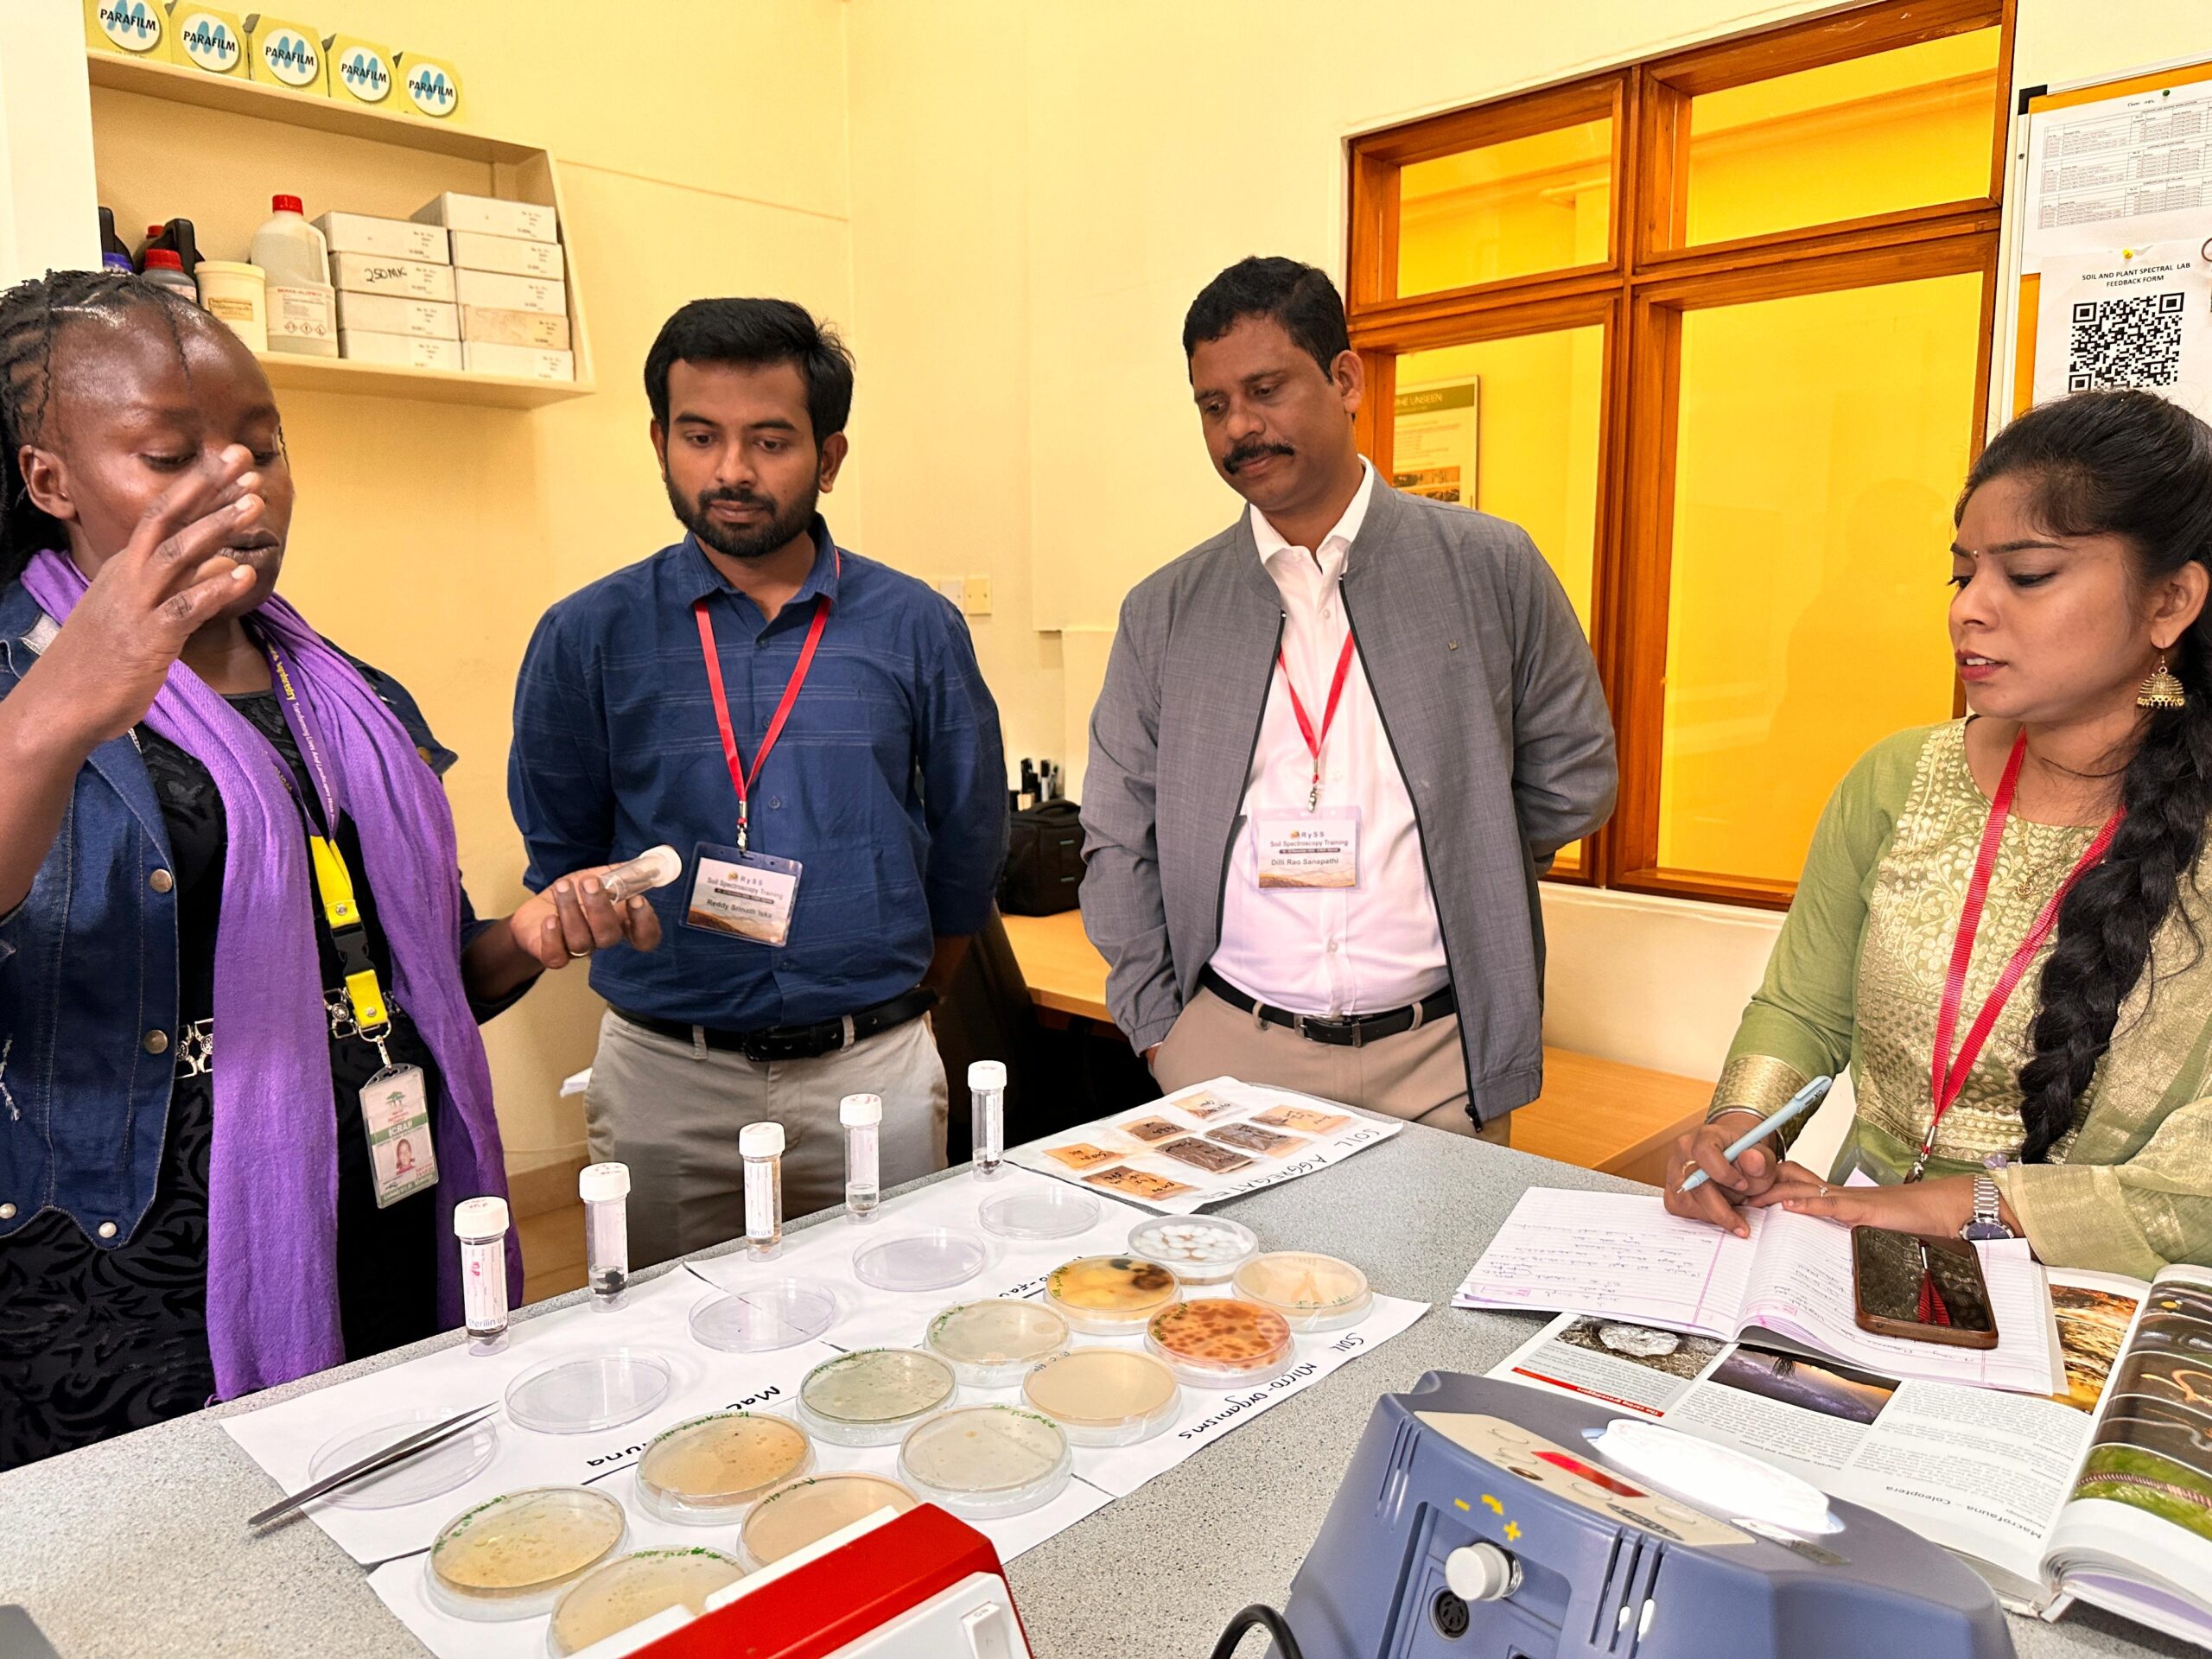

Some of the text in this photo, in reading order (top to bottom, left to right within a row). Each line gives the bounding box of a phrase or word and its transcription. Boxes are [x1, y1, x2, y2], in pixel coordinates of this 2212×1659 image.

[100, 9, 156, 30] PARAFILM
[183, 30, 235, 52] PARAFILM
[265, 46, 314, 66] PARAFILM
[340, 62, 386, 83] PARAFILM
[409, 79, 453, 98] PARAFILM
[2139, 264, 2173, 274] SPECTRAL
[2106, 278, 2141, 287] FEEDBACK
[720, 880, 759, 894] Spectroscopy
[760, 888, 783, 899] Training
[707, 899, 728, 911] Reddy
[1333, 1128, 1380, 1147] SOIL
[467, 1317, 496, 1328] Sterilin
[1329, 1332, 1364, 1352] SOIL
[1576, 1387, 1622, 1403] gravediggers
[1622, 1401, 1644, 1410] caring
[1885, 1485, 2042, 1539] Macrofauna Coleoptera
